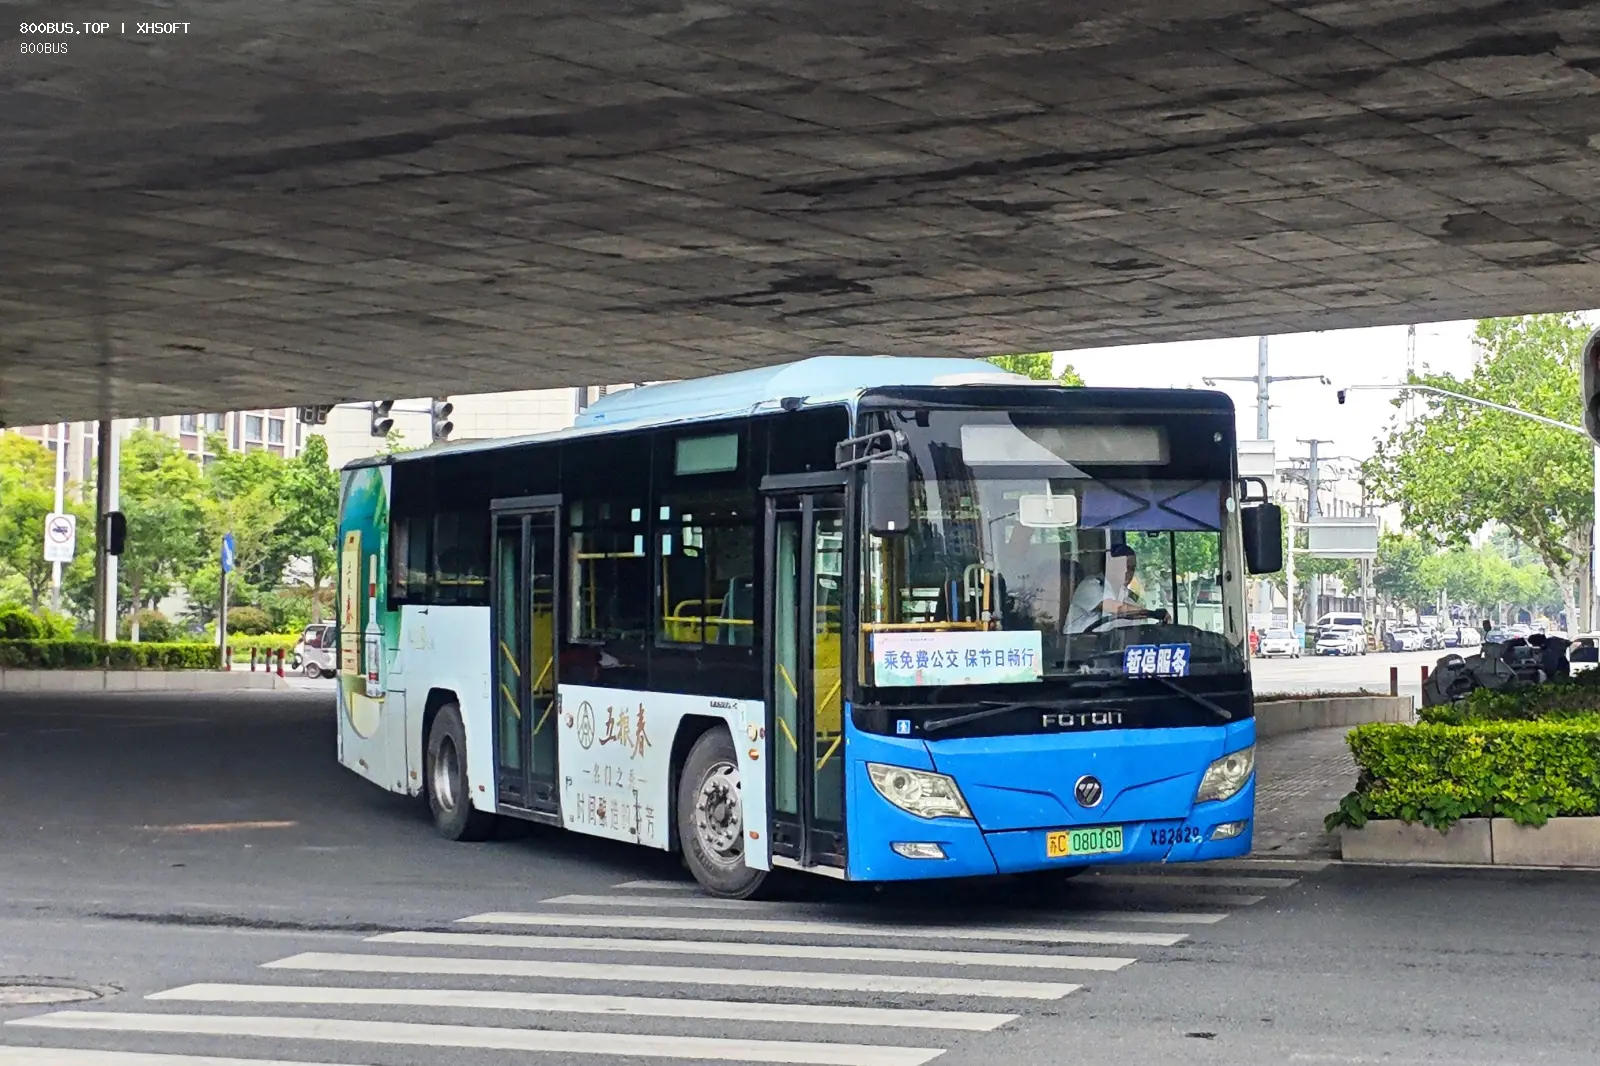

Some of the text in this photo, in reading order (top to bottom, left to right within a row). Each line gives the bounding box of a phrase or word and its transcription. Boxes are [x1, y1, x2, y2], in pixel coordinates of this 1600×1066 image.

[884, 647, 1034, 670] 乘免费公交 保节日畅行
[1126, 647, 1187, 678] 暂停服务
[1042, 711, 1122, 728] FOTON
